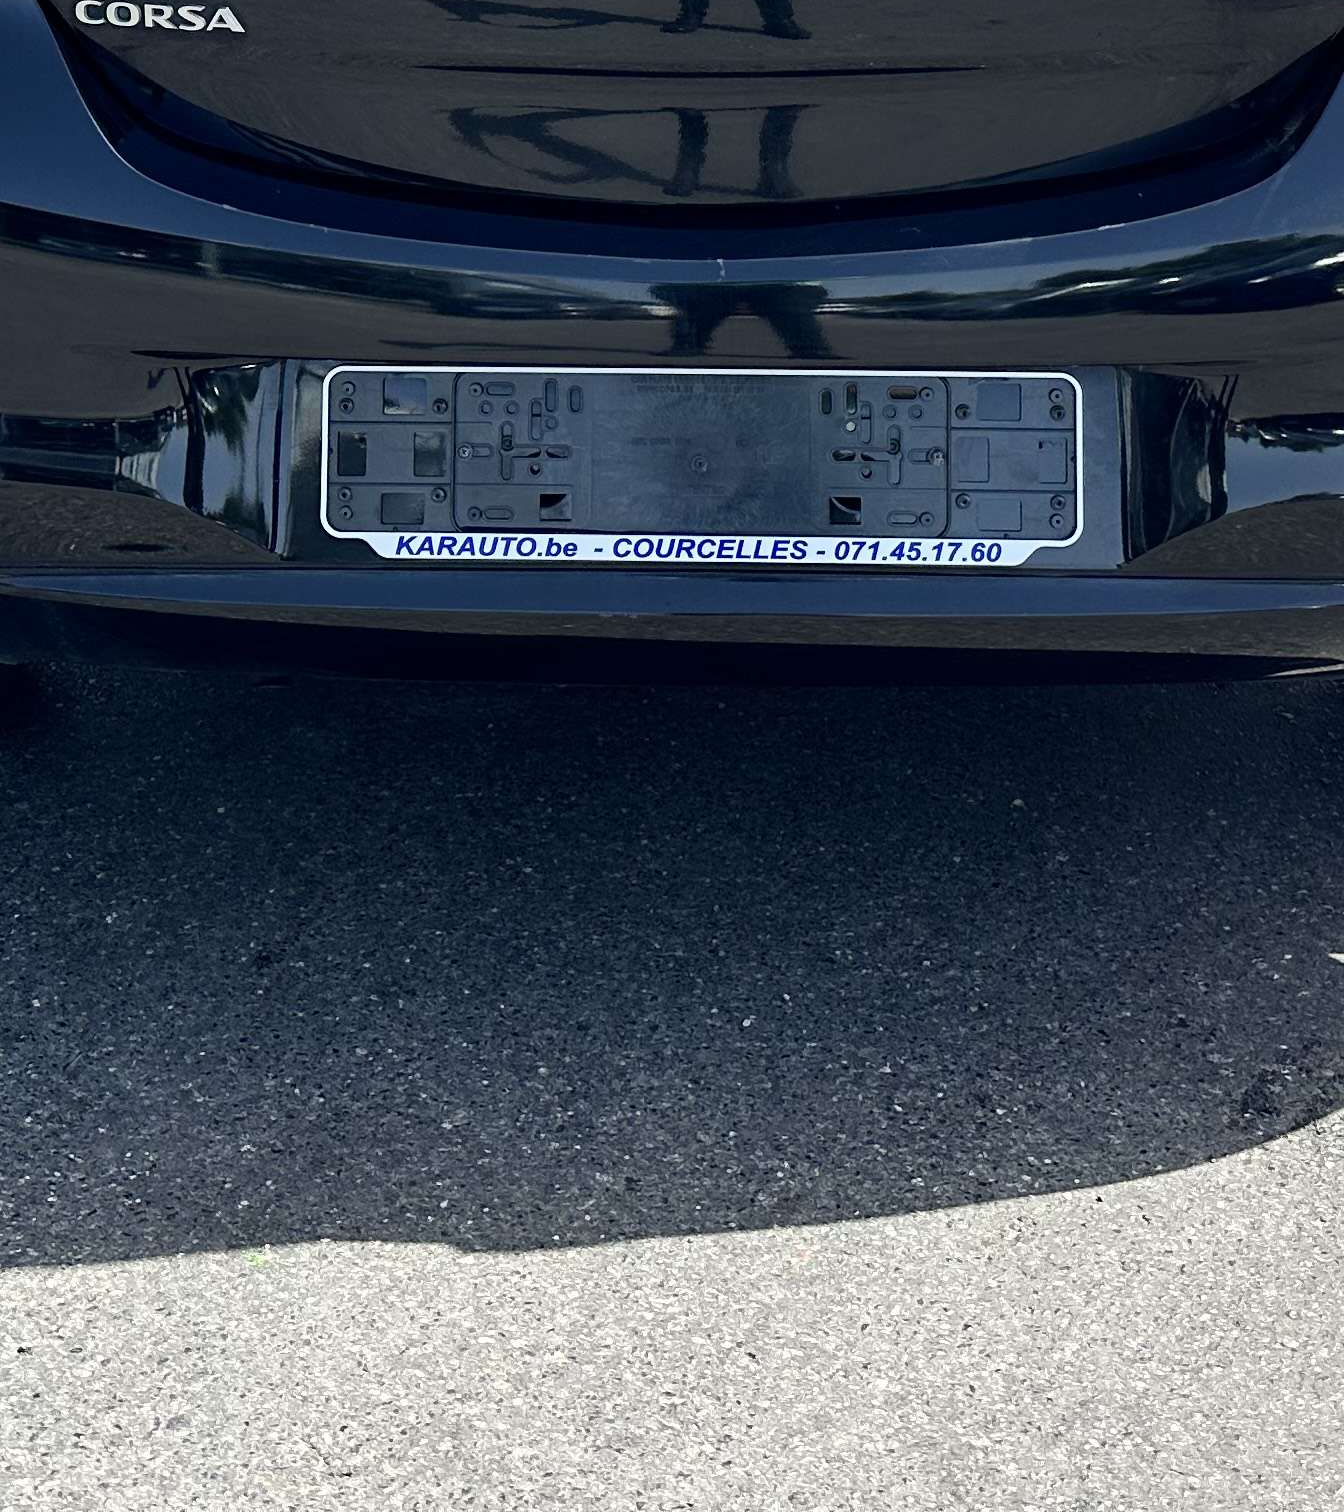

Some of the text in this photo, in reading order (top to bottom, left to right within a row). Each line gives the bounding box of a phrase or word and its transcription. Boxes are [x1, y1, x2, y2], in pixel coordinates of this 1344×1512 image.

[75, 0, 246, 33] CORSA
[395, 535, 578, 557] KARAUTO.be
[612, 538, 809, 561] COURCELLES
[834, 540, 1002, 563] 071.45.17.60
